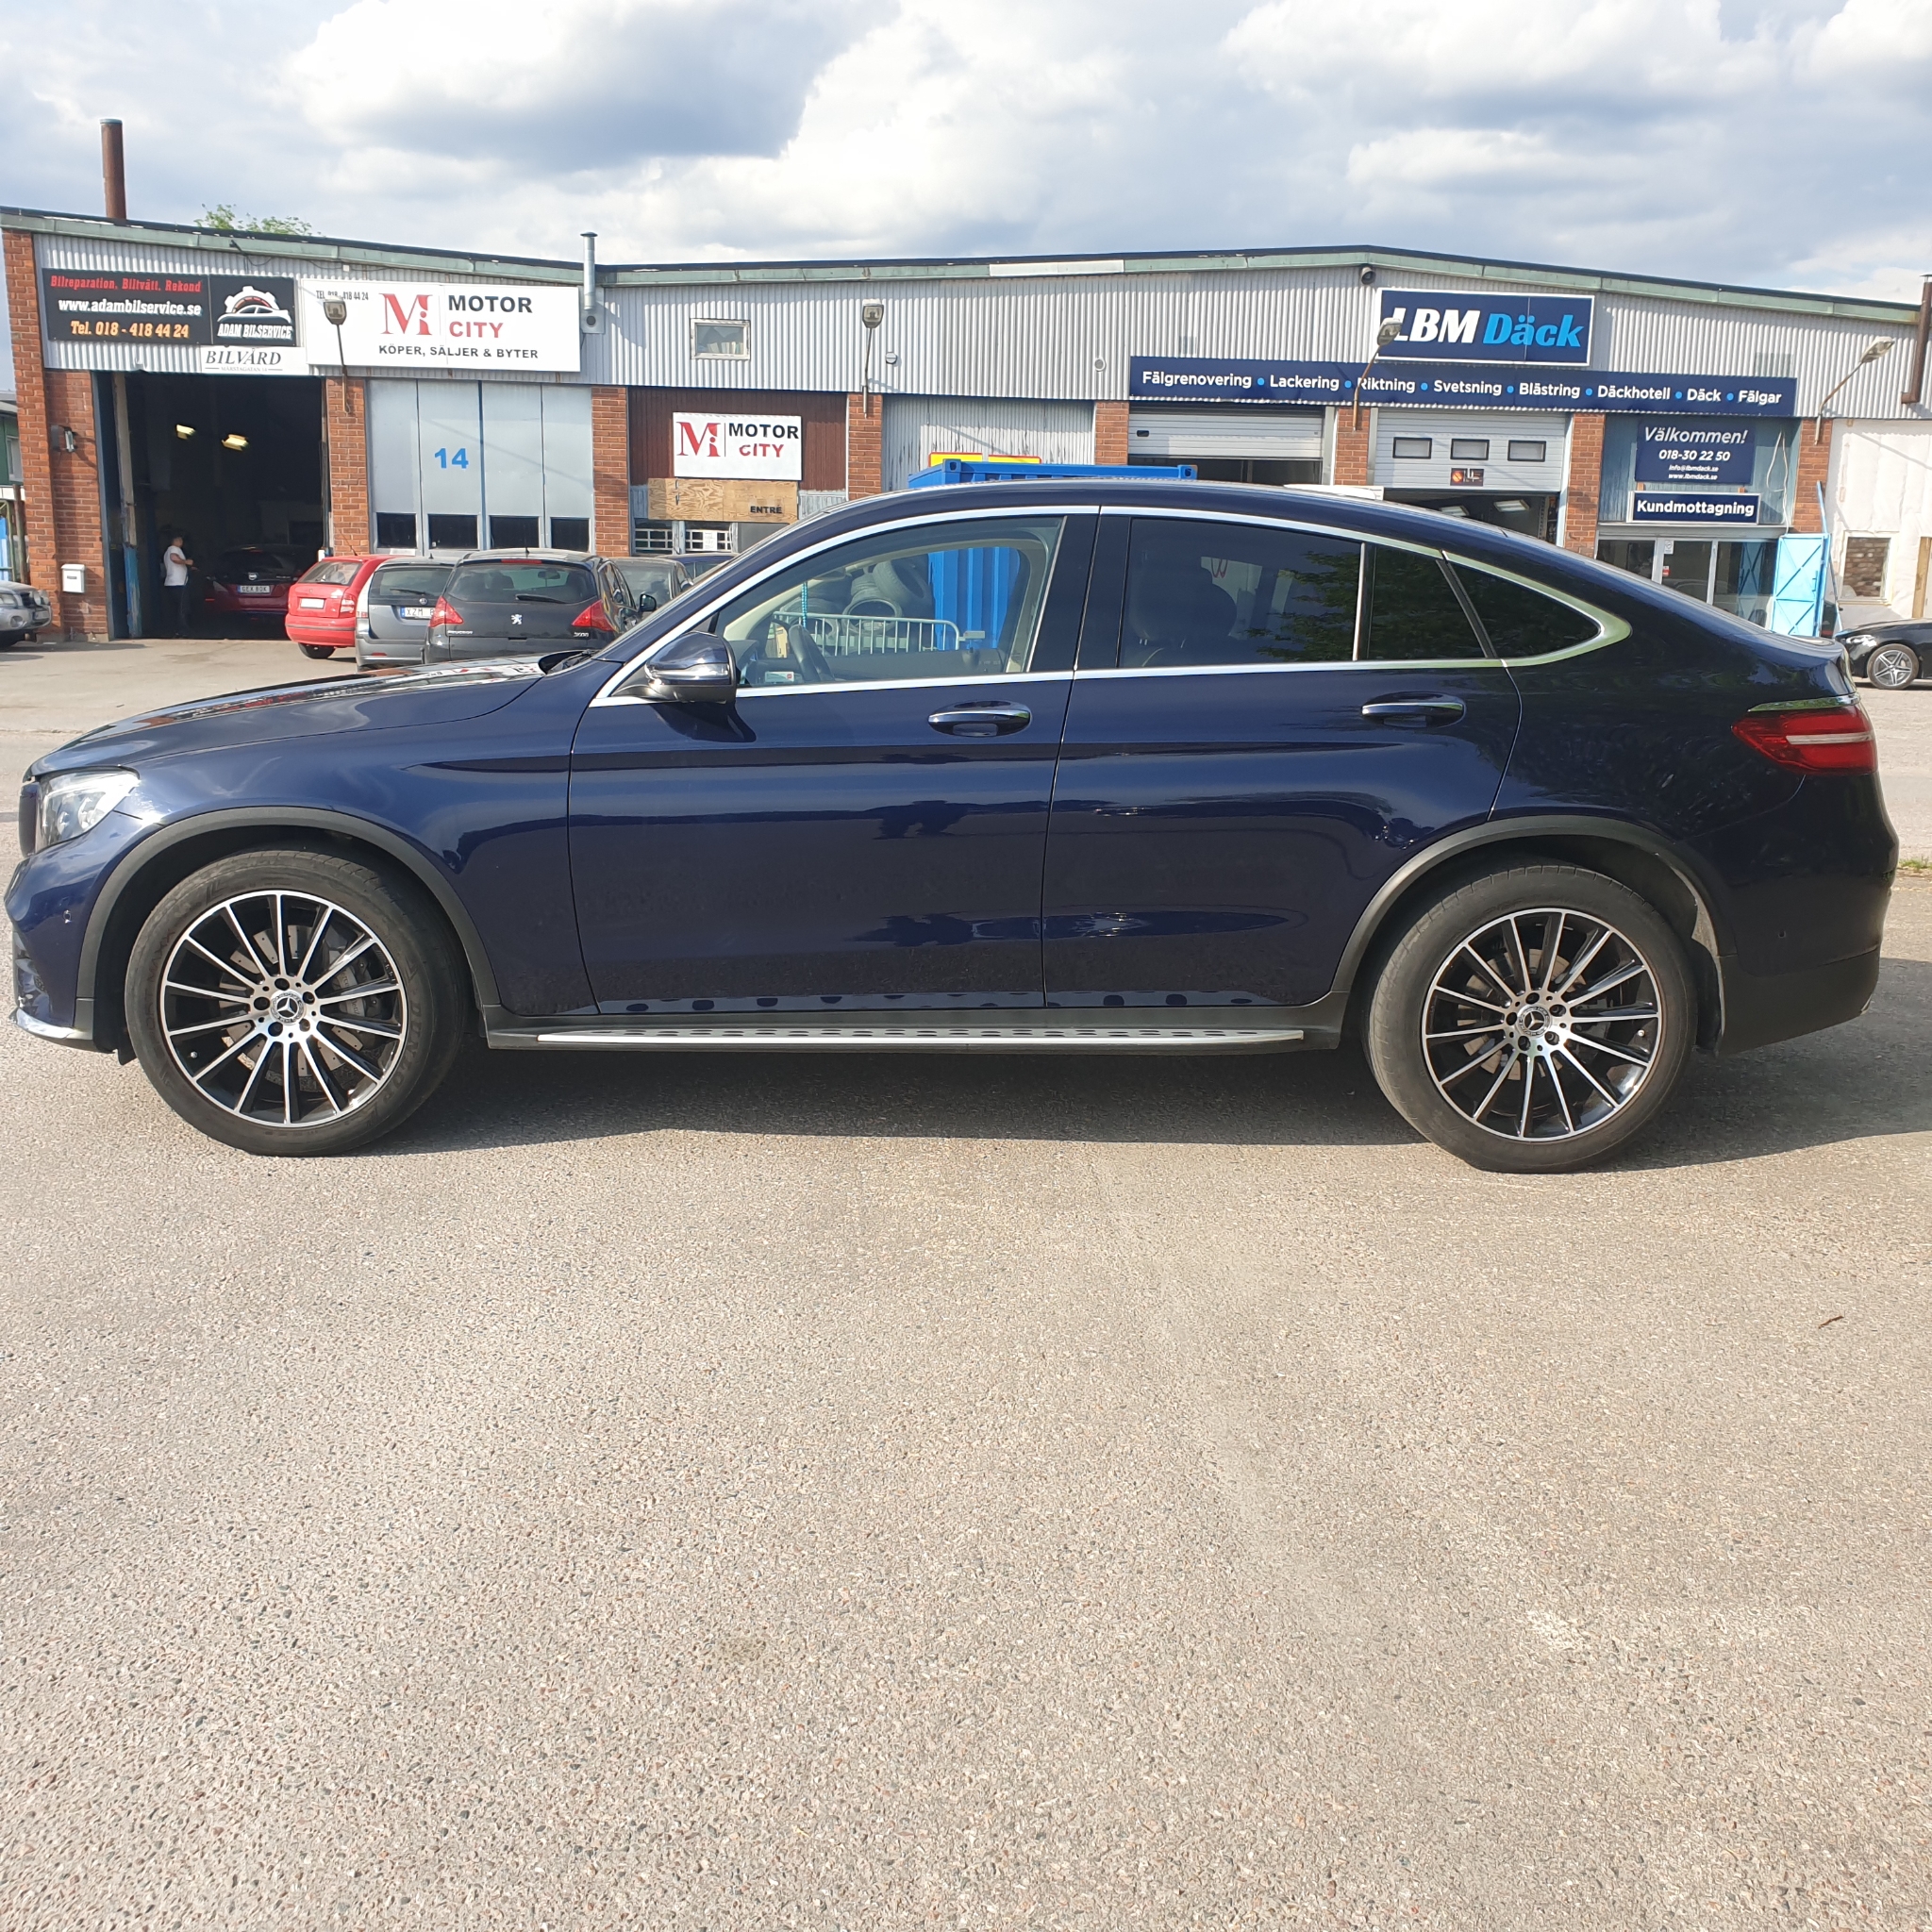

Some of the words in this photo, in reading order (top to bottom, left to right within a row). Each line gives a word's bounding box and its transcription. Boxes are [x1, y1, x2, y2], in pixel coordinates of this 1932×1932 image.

[165, 279, 202, 292] Rekond
[58, 298, 202, 316] www.adambilservice.se
[448, 295, 533, 313] MOTOR
[71, 321, 92, 335] Tel.
[95, 321, 119, 336] 018
[129, 323, 153, 337] 418
[155, 324, 171, 338] 44
[173, 324, 190, 339] 24
[217, 323, 242, 338] ADAM
[242, 324, 293, 341] BILSERVICE
[449, 321, 504, 339] CITY
[1392, 308, 1481, 343] LBM
[1482, 313, 1584, 347] Däck
[206, 347, 281, 365] BILVÅRD
[379, 343, 425, 357] KÖPER,
[430, 344, 479, 358] SÄLJER
[483, 349, 492, 358] &
[496, 349, 539, 358] BYTER
[1142, 371, 1252, 389] Fälgrenovering
[1270, 375, 1340, 391] Lackering
[1357, 377, 1415, 393] Riktning
[1434, 379, 1503, 396] Svetsning
[1519, 382, 1580, 398] Blästring
[1597, 385, 1671, 400] Däckhotell
[1687, 387, 1721, 402] Däck
[1739, 389, 1781, 405] Fälgar
[729, 423, 799, 439] MOTOR
[1644, 426, 1748, 444] Välkommen!
[435, 448, 469, 469] 14
[739, 443, 784, 458] CITY
[1658, 449, 1698, 460] 018-30
[1699, 451, 1713, 461] 22
[1715, 451, 1731, 461] 50
[750, 504, 782, 514] ENTRÉ
[1637, 500, 1755, 517] Kundmottagning
